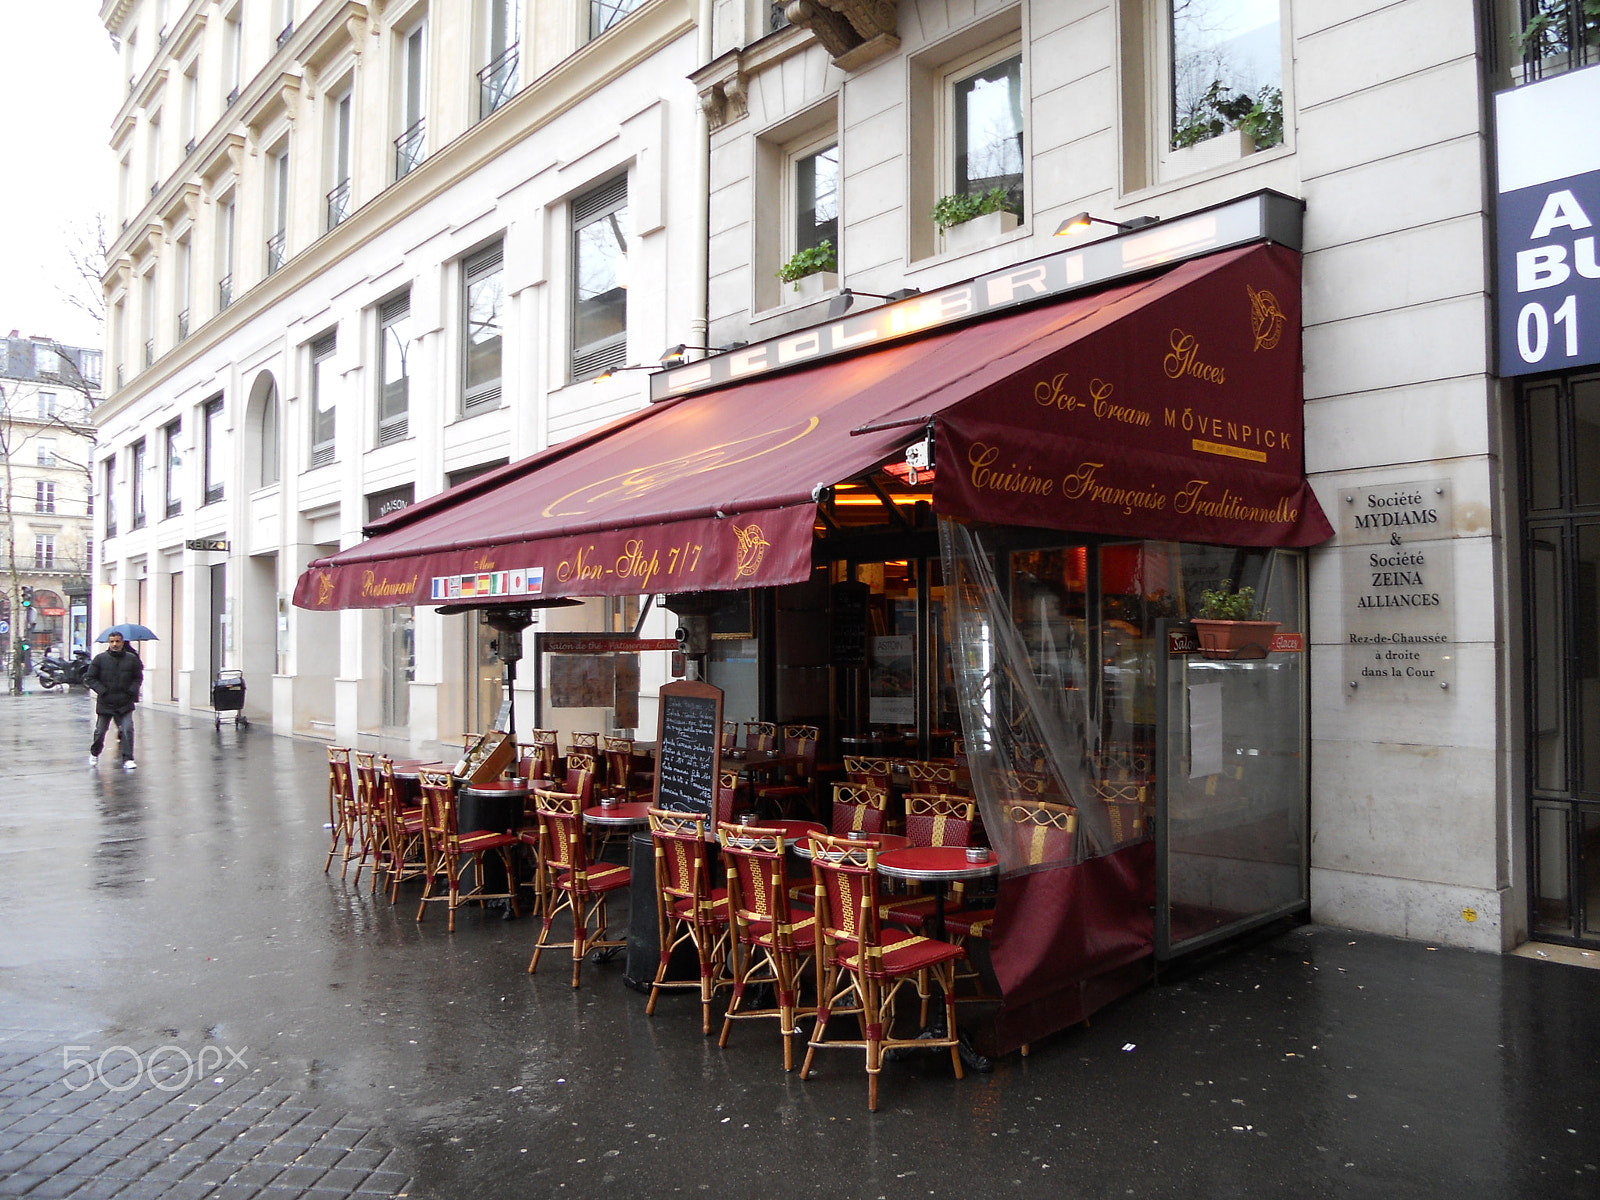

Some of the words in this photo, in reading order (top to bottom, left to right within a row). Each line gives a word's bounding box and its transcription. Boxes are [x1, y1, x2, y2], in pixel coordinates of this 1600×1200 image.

[1529, 188, 1593, 241] A
[729, 253, 1085, 377] COLIBRI
[1516, 294, 1579, 364] 01
[1163, 327, 1226, 386] Glaces
[1034, 372, 1151, 428] Ice-Cream
[968, 441, 1054, 495] Cuisine
[1062, 462, 1167, 516] Française
[1173, 479, 1299, 525] Traditionnelle
[380, 499, 408, 517] MAISON
[1367, 490, 1422, 508] Société
[1354, 508, 1438, 529] MYDIAMS
[186, 539, 226, 550] KENZO
[1389, 531, 1402, 546] &
[556, 538, 661, 589] Non-Stop
[667, 541, 703, 578] 7/7
[1369, 551, 1425, 568] Société
[361, 569, 418, 598] Restaurant
[1371, 571, 1424, 587] ZEINA
[1357, 593, 1440, 609] ALLIANCES
[548, 640, 574, 651] Salon
[655, 639, 679, 650] Glace
[1349, 632, 1448, 644] Rez-de-Chaussée
[1385, 650, 1420, 660] droite
[1361, 667, 1388, 677] dans
[1392, 667, 1402, 677] la
[1406, 667, 1436, 677] Cour
